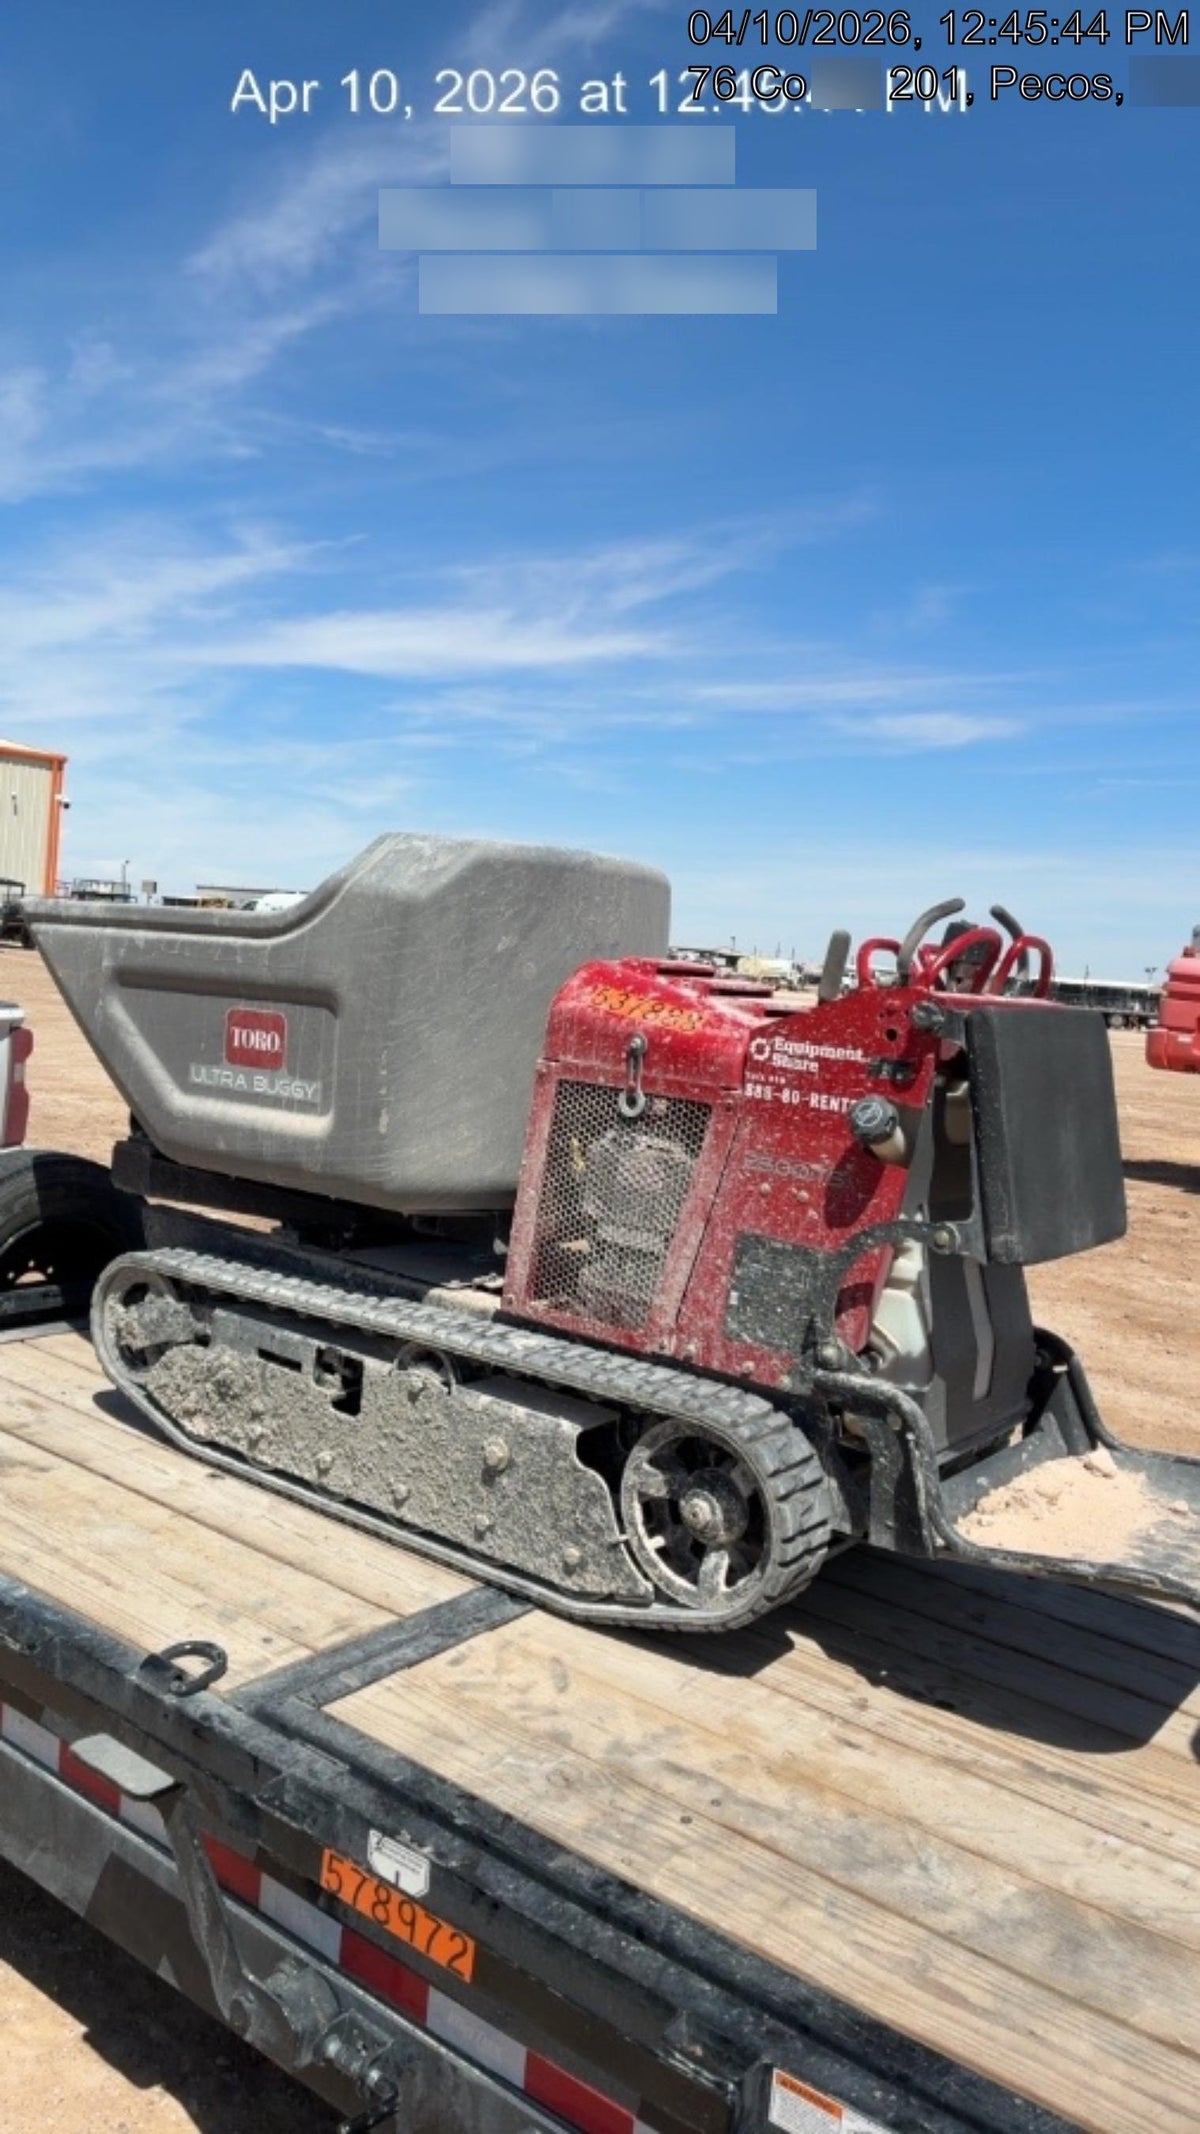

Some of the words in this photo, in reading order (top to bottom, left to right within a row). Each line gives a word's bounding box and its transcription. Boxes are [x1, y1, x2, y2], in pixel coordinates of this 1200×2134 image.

[230, 1027, 281, 1053] TORO
[774, 1036, 864, 1063] Equipment
[772, 1052, 820, 1073] Share
[191, 1065, 248, 1089] ULTRA
[253, 1075, 317, 1099] BUGGY
[325, 1854, 468, 1977] 578972
